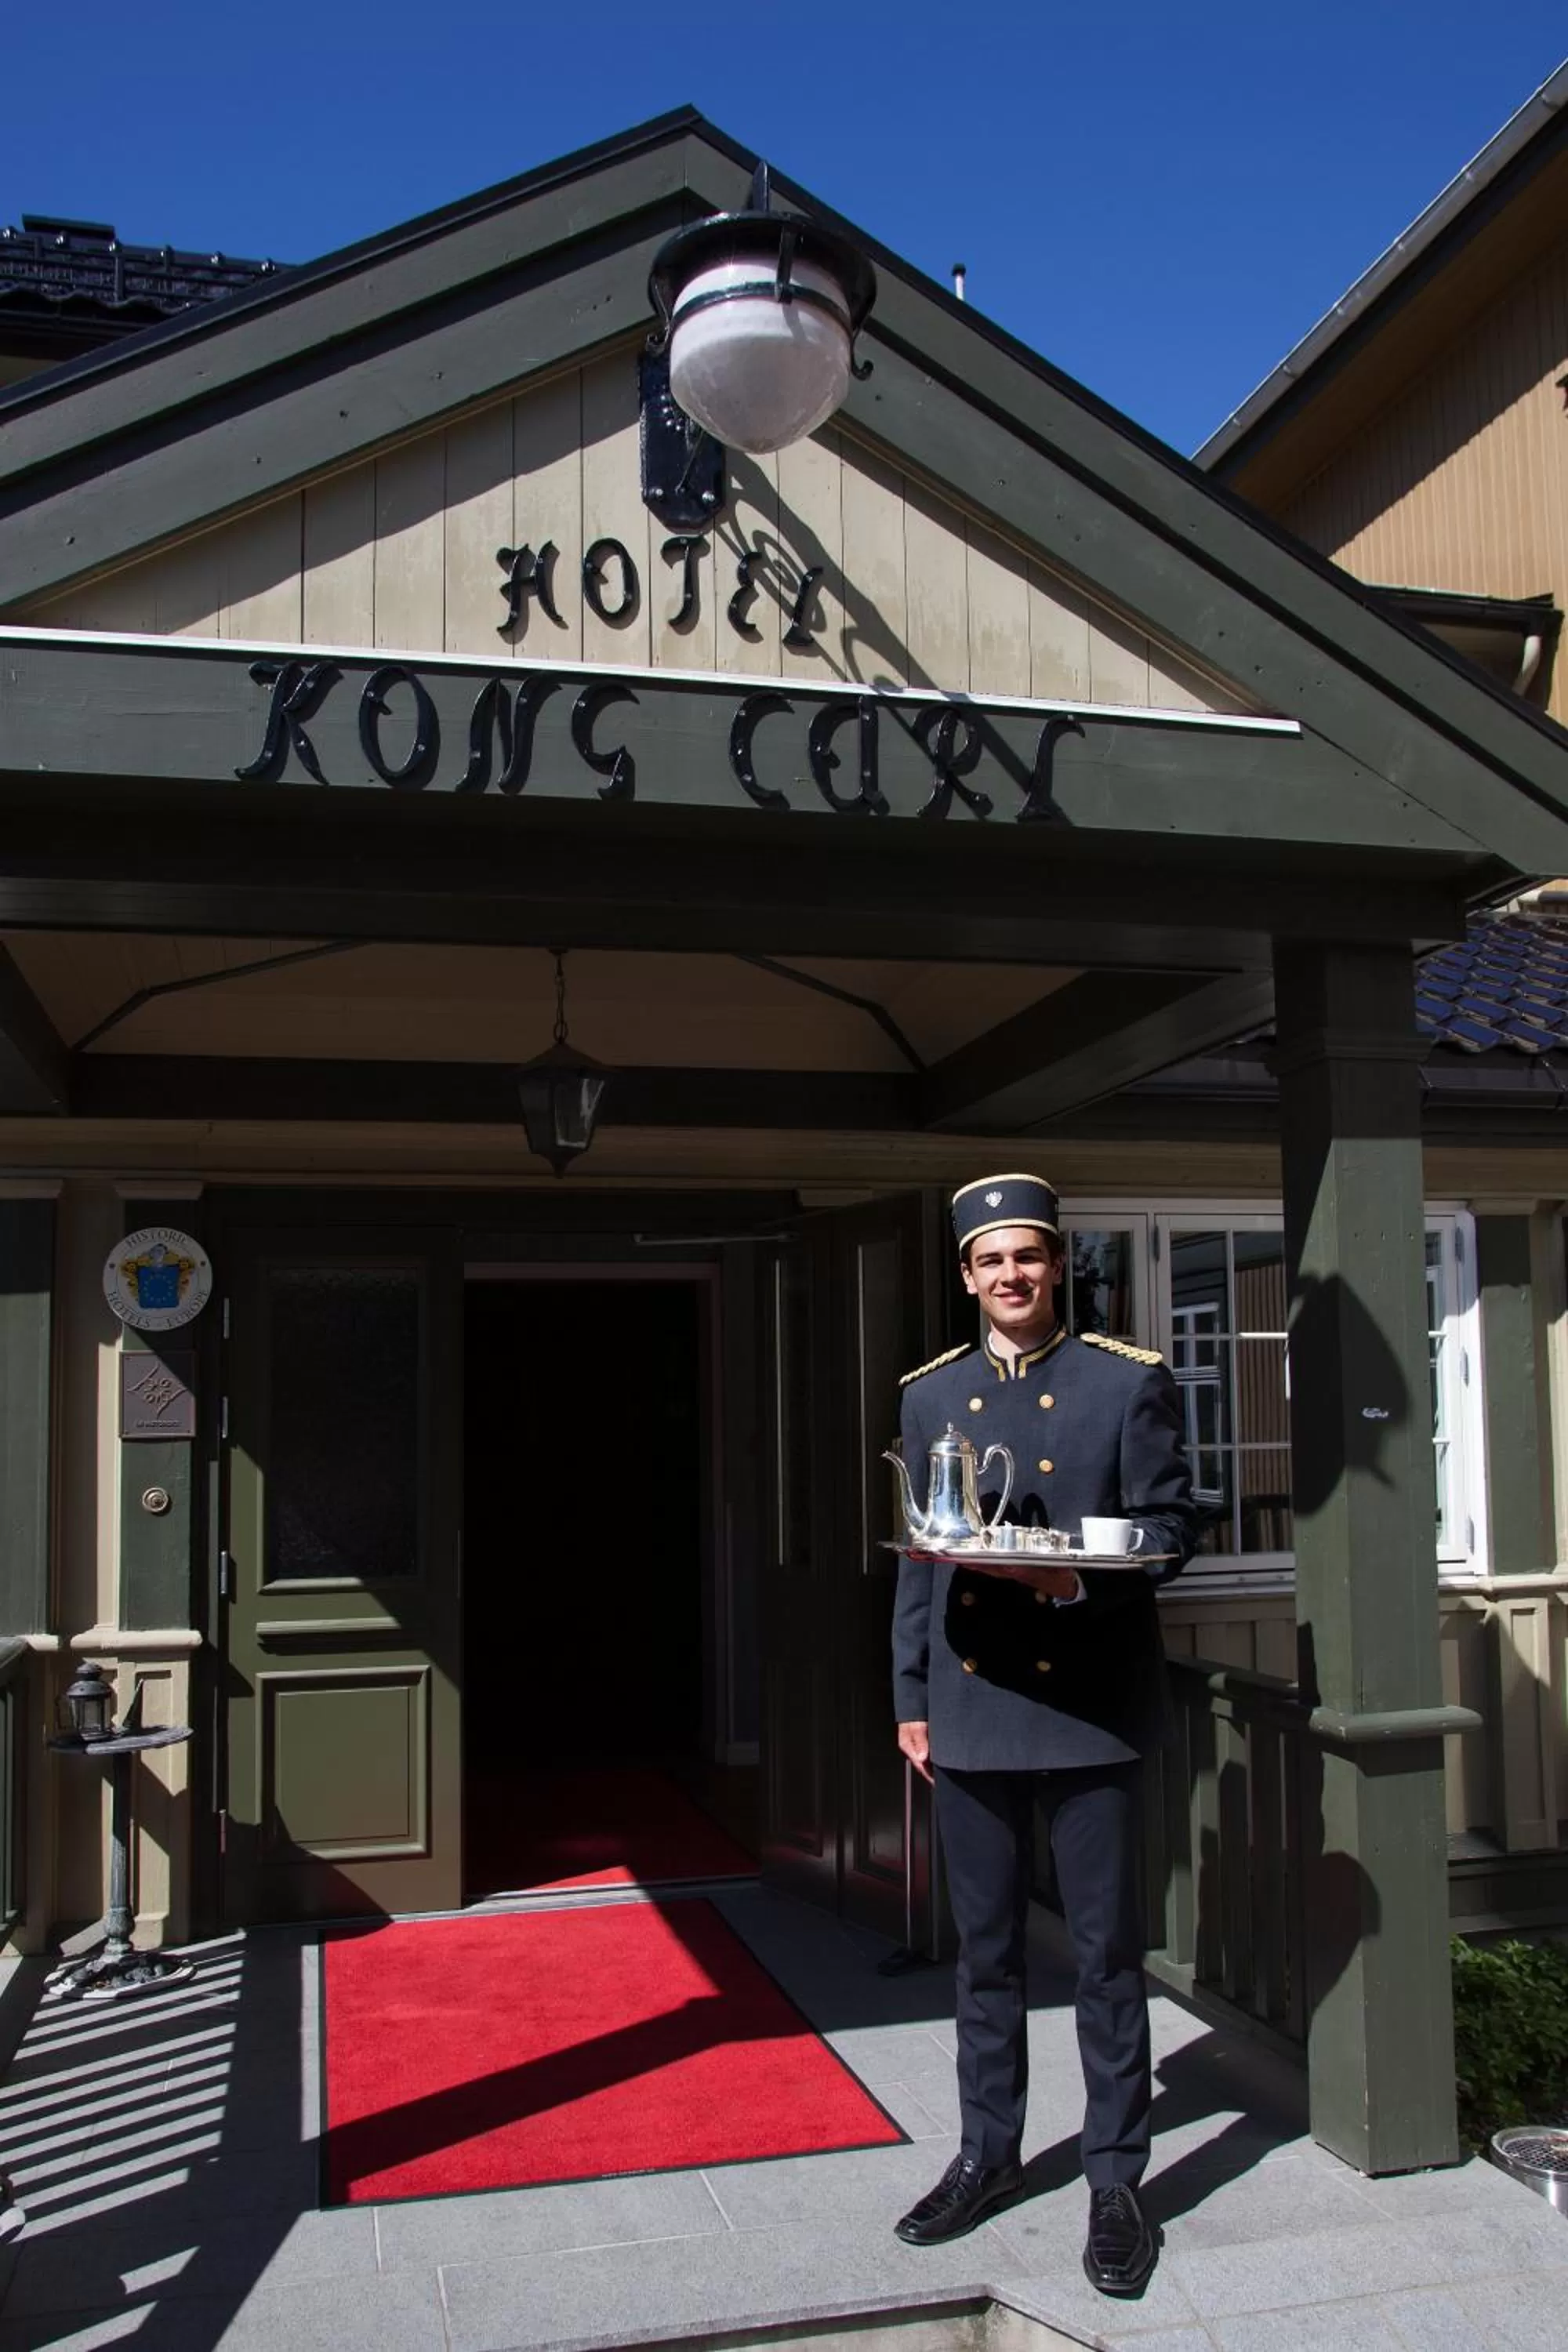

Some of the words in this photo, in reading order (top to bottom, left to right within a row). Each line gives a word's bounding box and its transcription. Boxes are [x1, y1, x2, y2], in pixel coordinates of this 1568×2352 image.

[496, 535, 823, 646] HOTEL
[235, 660, 640, 799] KONG
[728, 691, 1086, 824] CARL
